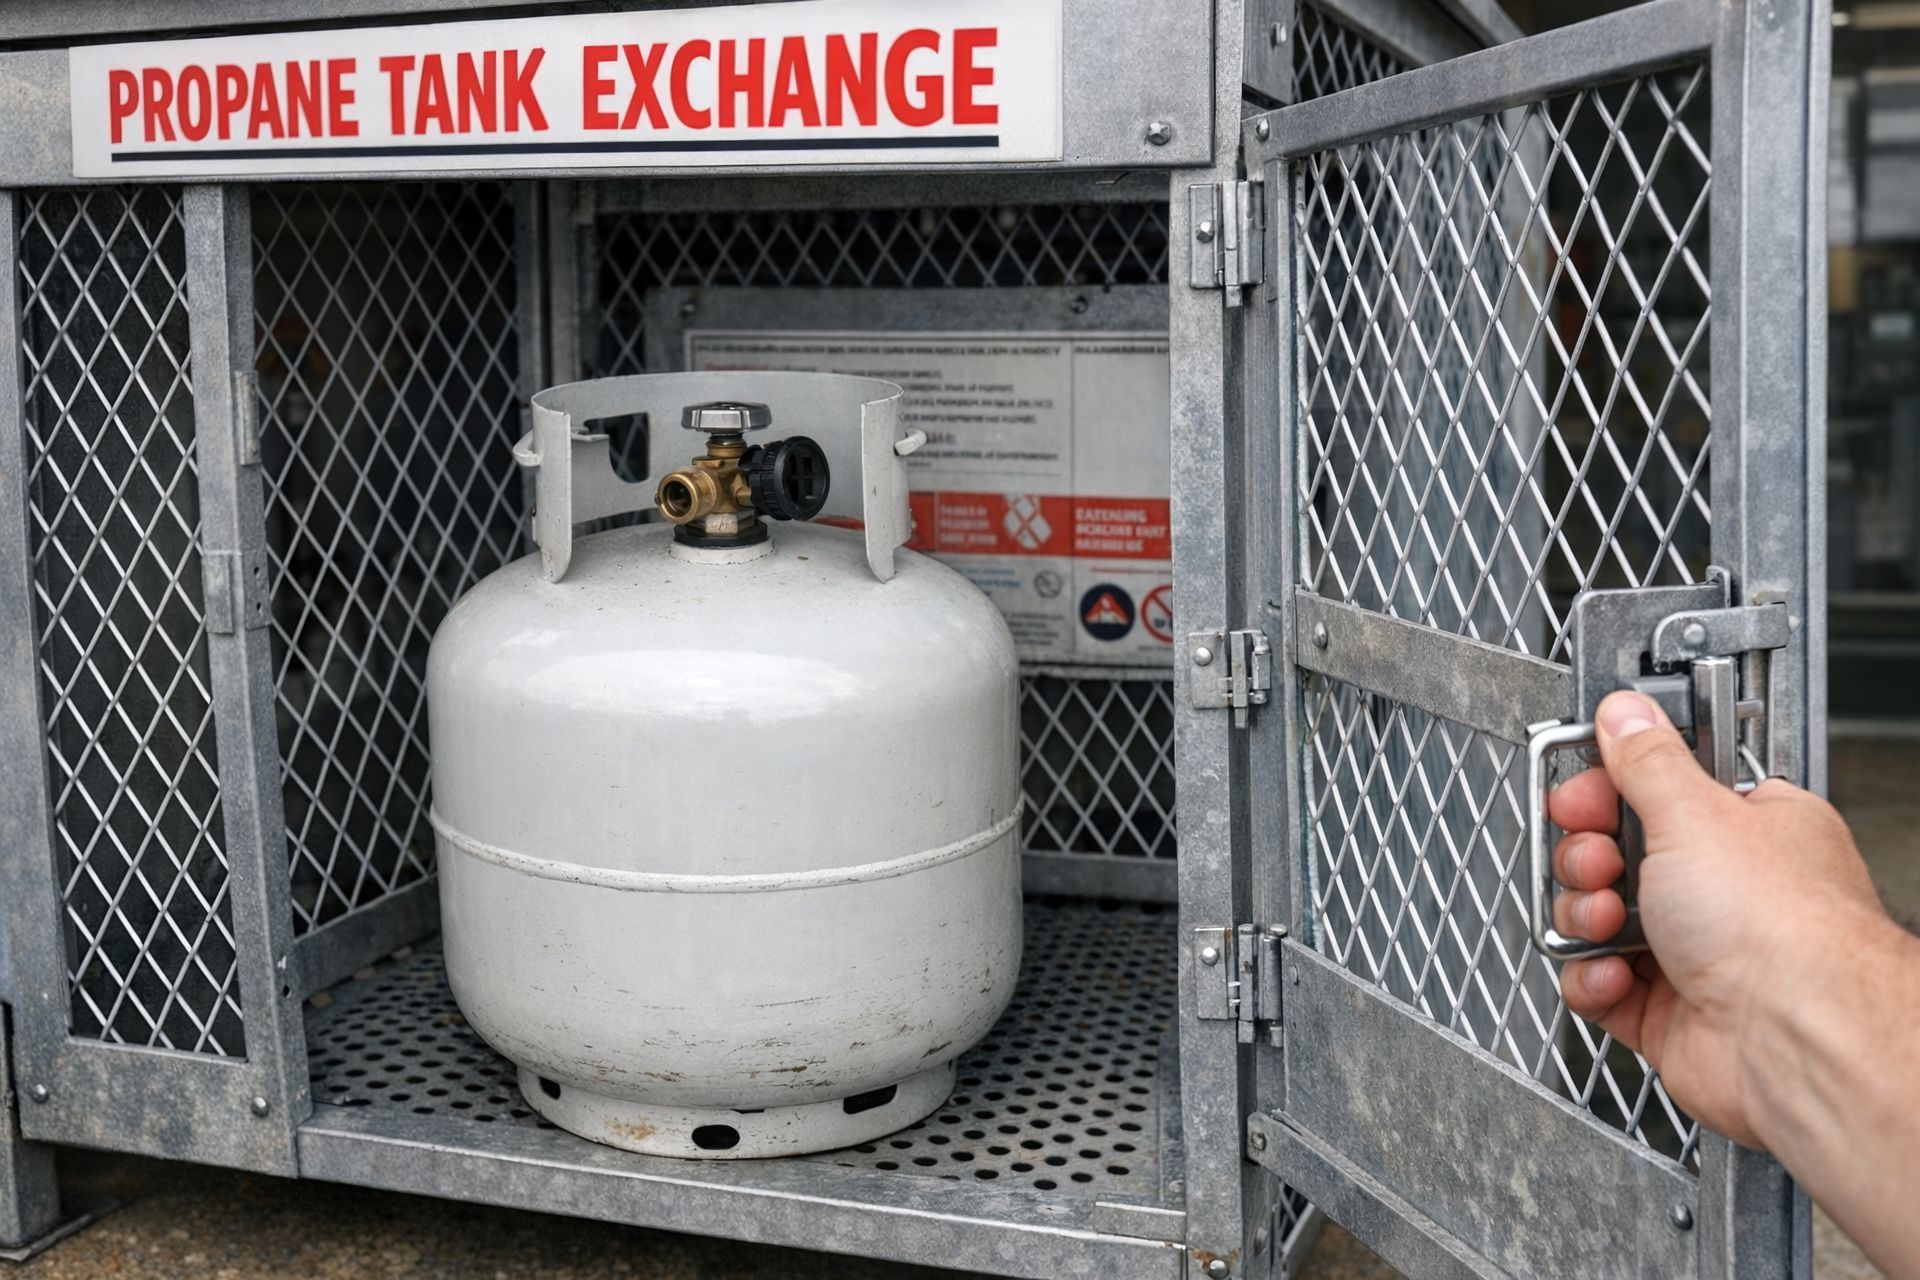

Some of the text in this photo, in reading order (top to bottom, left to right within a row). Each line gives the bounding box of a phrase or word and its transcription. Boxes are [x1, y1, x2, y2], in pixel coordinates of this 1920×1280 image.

[108, 27, 999, 144] PROPANE TANK EXCHANGE
